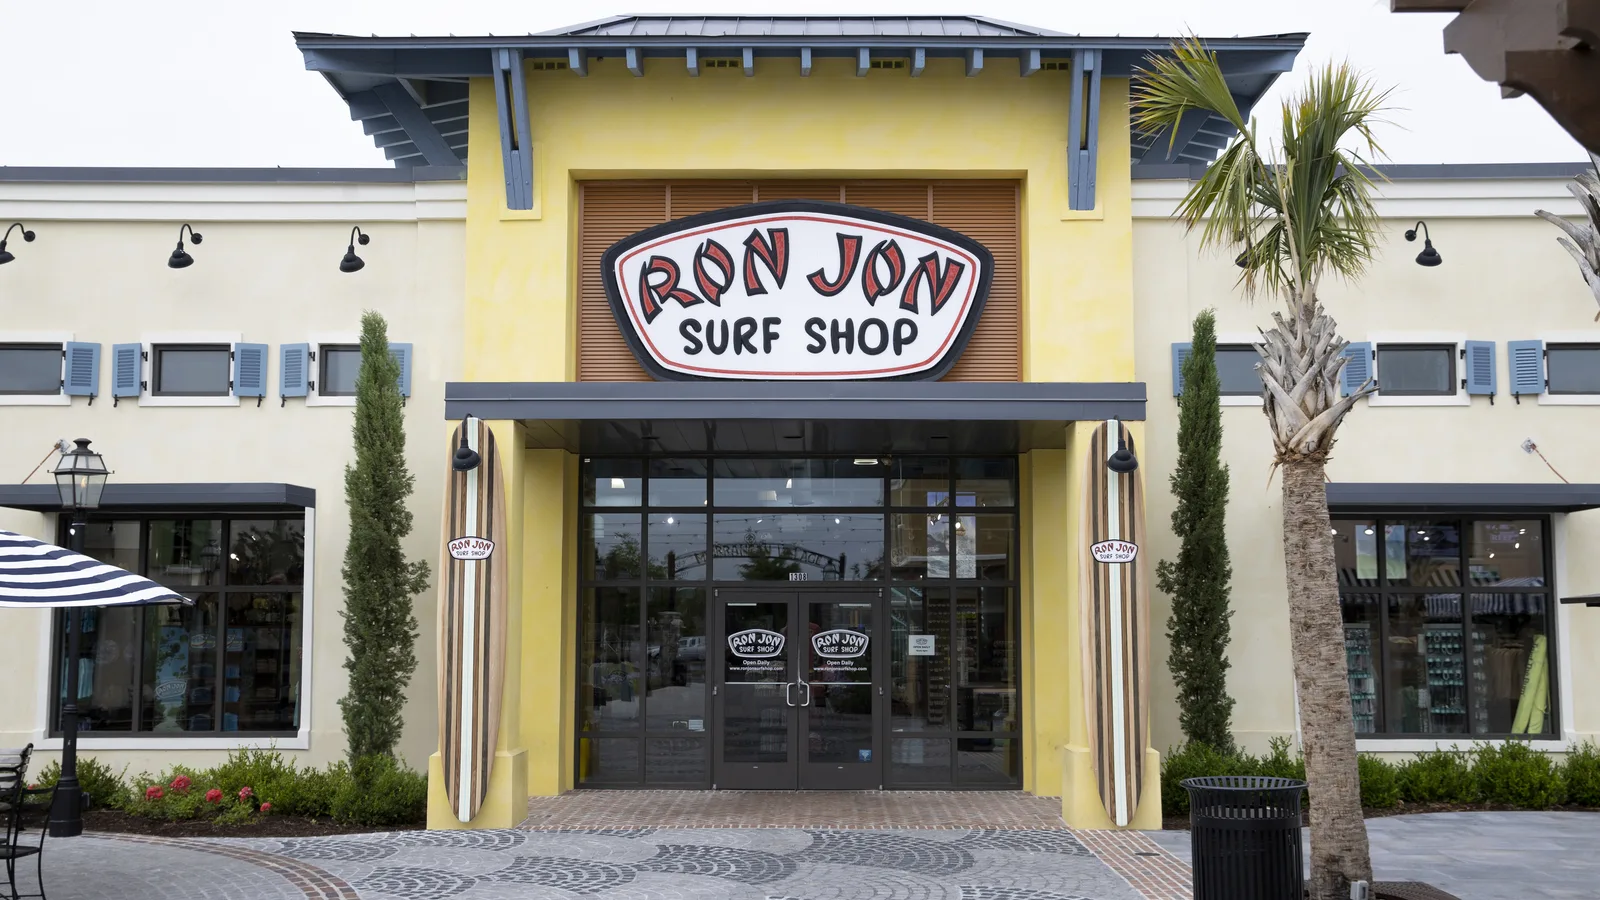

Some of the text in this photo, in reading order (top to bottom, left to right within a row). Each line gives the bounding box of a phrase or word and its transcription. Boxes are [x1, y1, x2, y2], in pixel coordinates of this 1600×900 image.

[638, 227, 965, 325] RON JON
[679, 316, 918, 356] SURF SHOP
[452, 540, 491, 551] RON JON
[1095, 543, 1135, 555] RON JON
[790, 573, 807, 581] 1308
[733, 632, 781, 648] RON JON
[816, 633, 865, 648] RON JON
[739, 645, 775, 653] SURF SHOP
[841, 659, 854, 667] Daily
